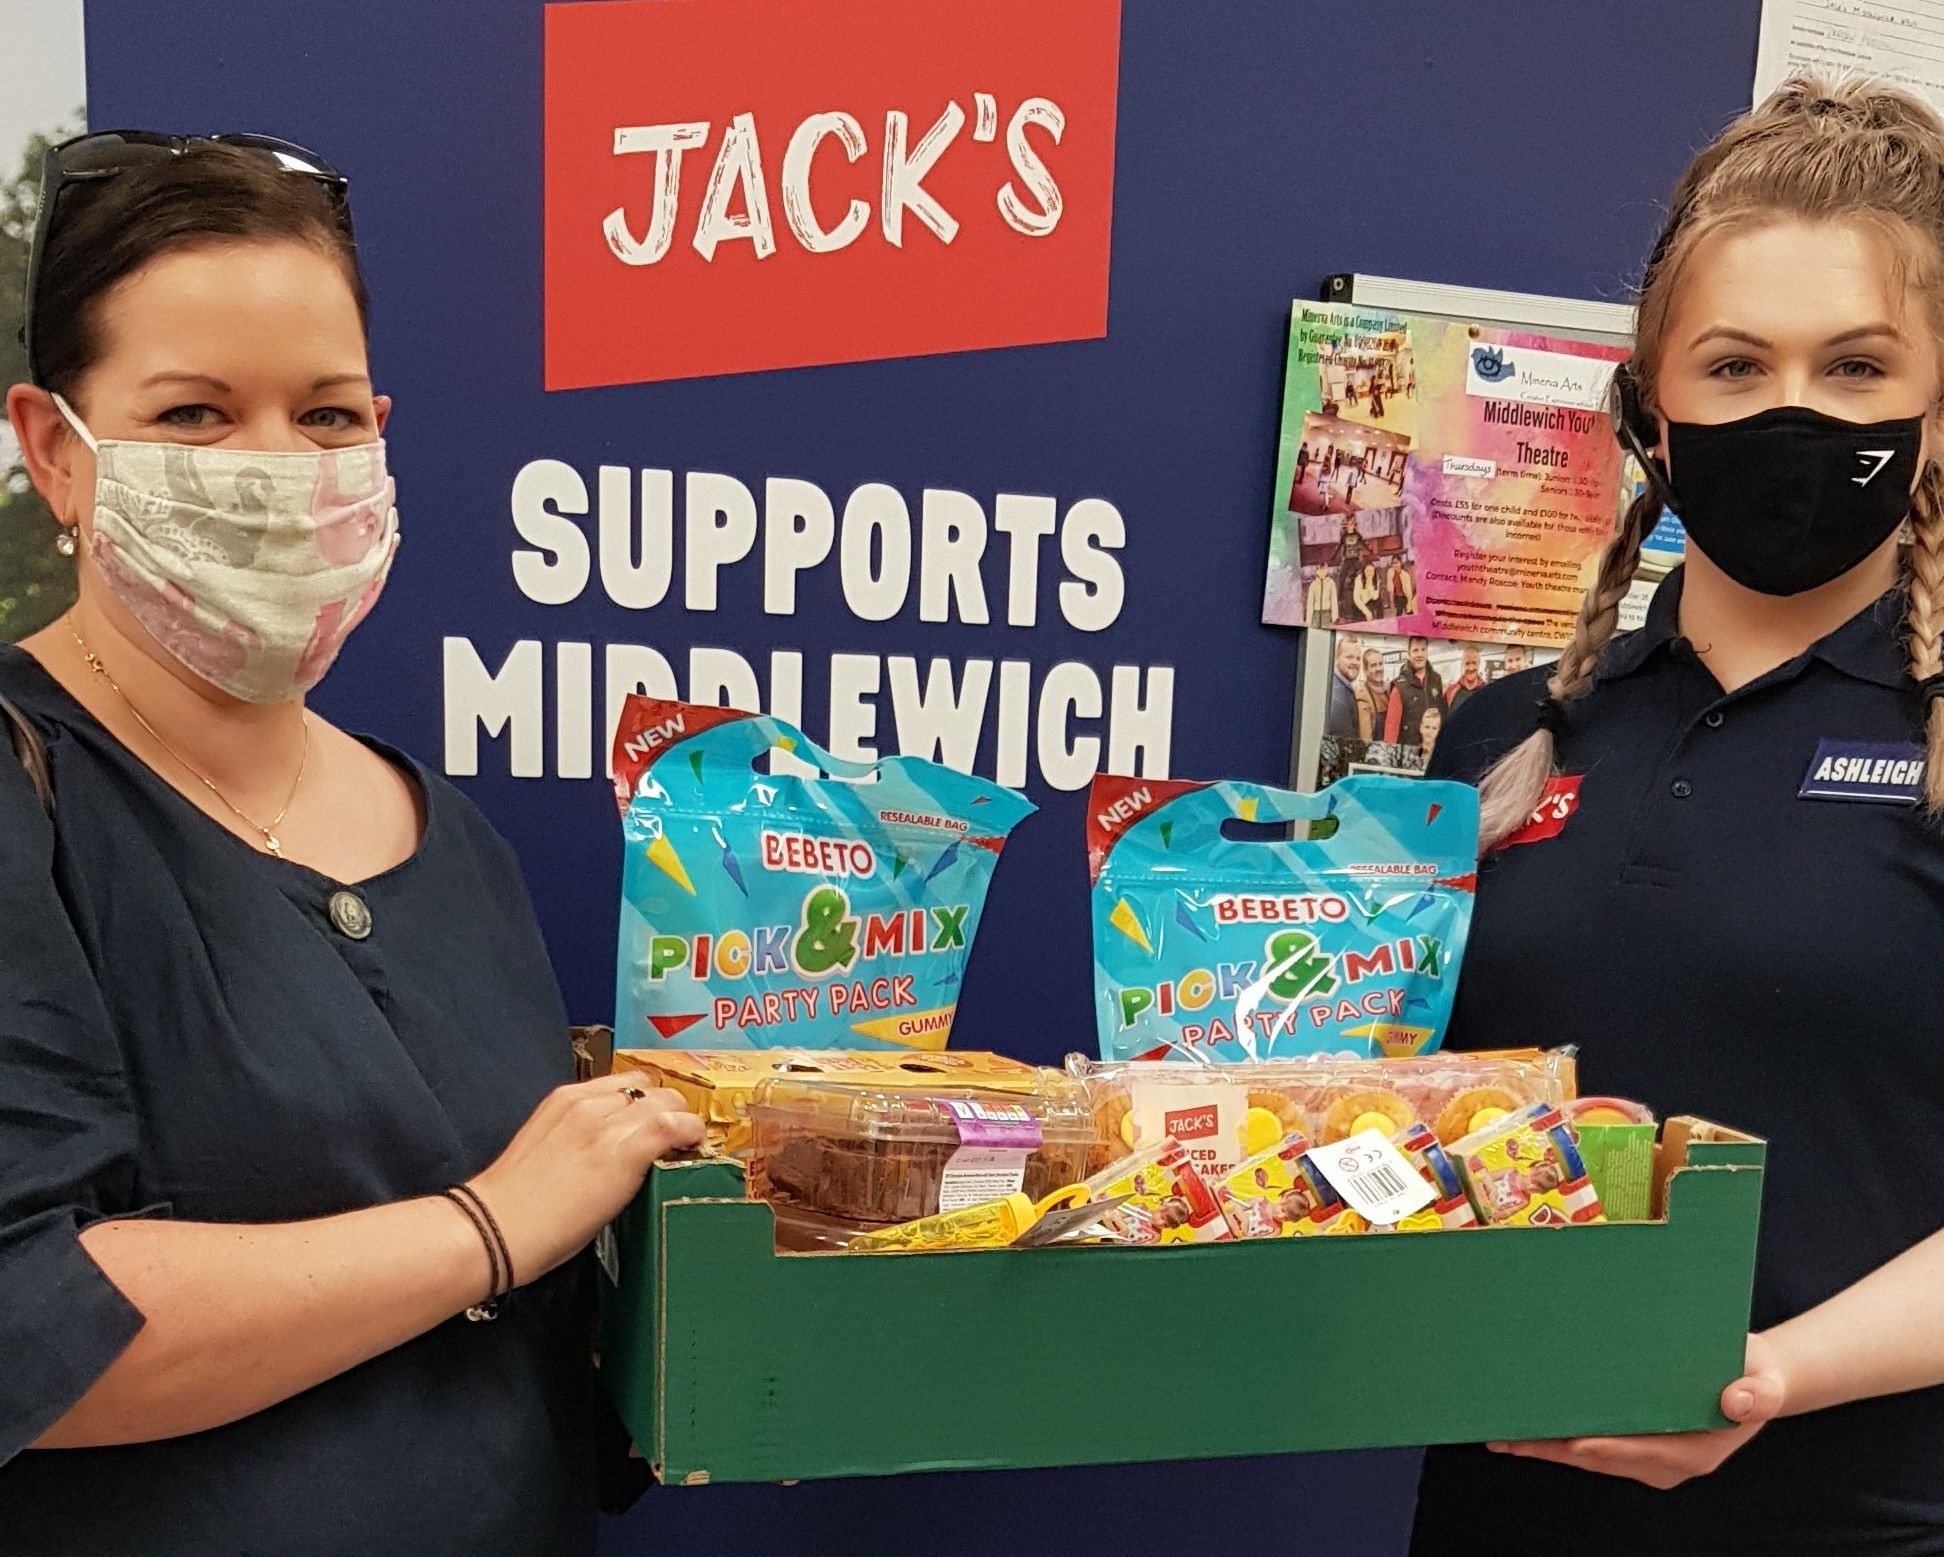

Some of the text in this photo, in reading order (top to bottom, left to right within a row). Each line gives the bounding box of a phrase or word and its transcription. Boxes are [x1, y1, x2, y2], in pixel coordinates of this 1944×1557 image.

[602, 92, 1066, 266] JACK'S
[1560, 377, 1583, 392] Arts
[1484, 401, 1564, 431] Middlewich
[1516, 441, 1569, 468] Theatre
[510, 457, 1127, 632] SUPPORTS
[623, 714, 686, 763] NEW
[1813, 756, 1925, 785] ASHLEIGH
[879, 811, 968, 832] RESEALABLE BAG
[1097, 787, 1153, 832] NEW
[763, 833, 874, 876] BEBETO
[1413, 865, 1437, 875] BAG
[1217, 896, 1347, 925] BEBETO
[649, 885, 970, 980] PICK & MIX
[1119, 929, 1443, 1029] PICK & MIX
[714, 975, 917, 1030] PARTY PACK
[1311, 988, 1406, 1027] PACK
[898, 1012, 955, 1036] GUMMY
[1169, 1113, 1215, 1134] JACK'S
[1187, 1149, 1217, 1161] CED
[1194, 1163, 1236, 1176] AKE
